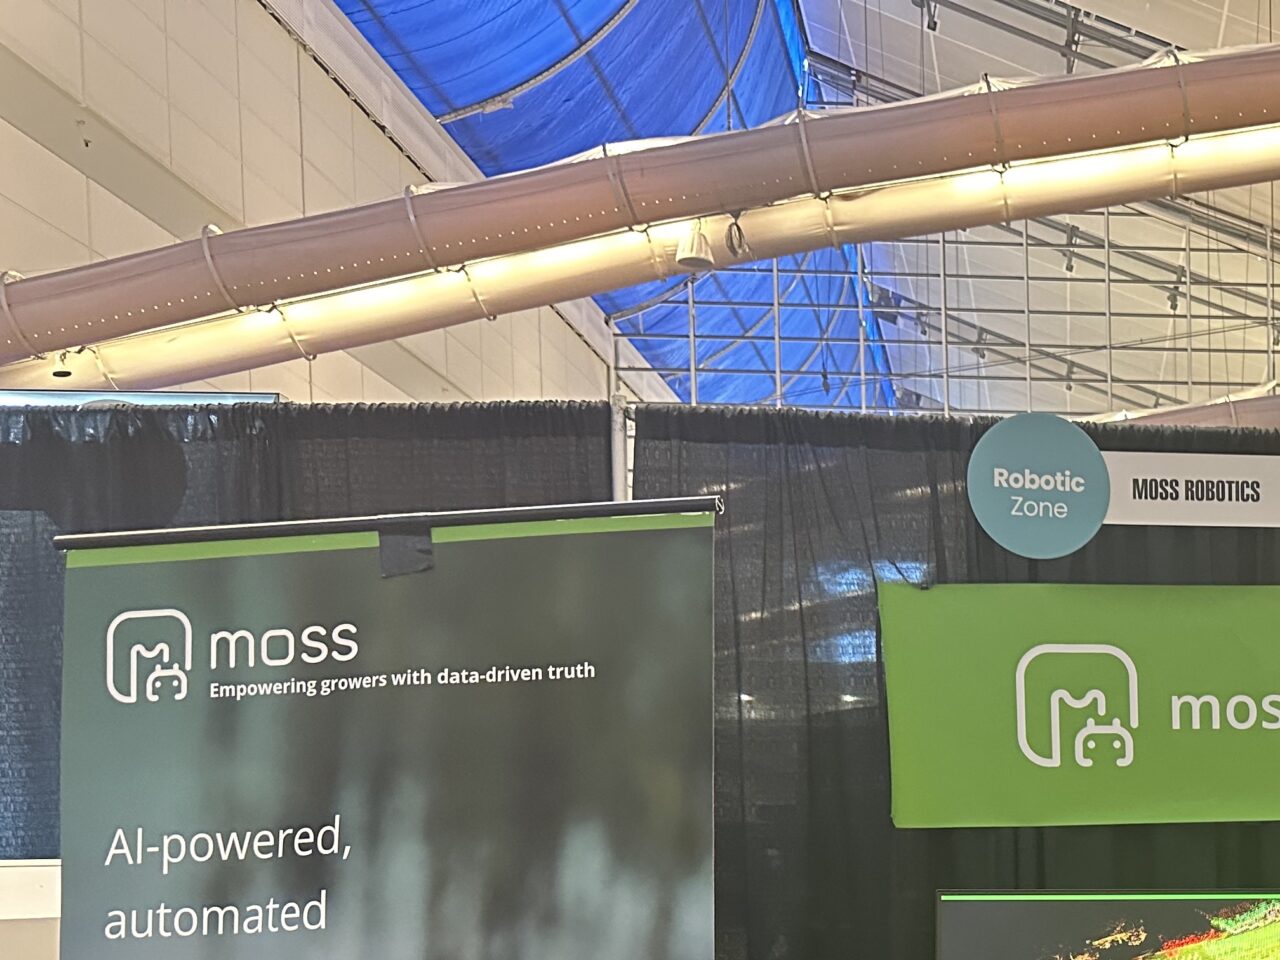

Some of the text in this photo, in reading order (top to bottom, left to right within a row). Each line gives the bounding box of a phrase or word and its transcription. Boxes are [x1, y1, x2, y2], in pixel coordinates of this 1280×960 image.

[993, 468, 1085, 492] Robotic
[1132, 478, 1261, 503] MOSS ROBOTICS
[1010, 496, 1068, 518] Zone
[210, 623, 359, 670] moss
[210, 661, 596, 700] Empowering growers with data-driven truth
[104, 814, 352, 875] AI-powered,
[104, 889, 327, 940] automated
